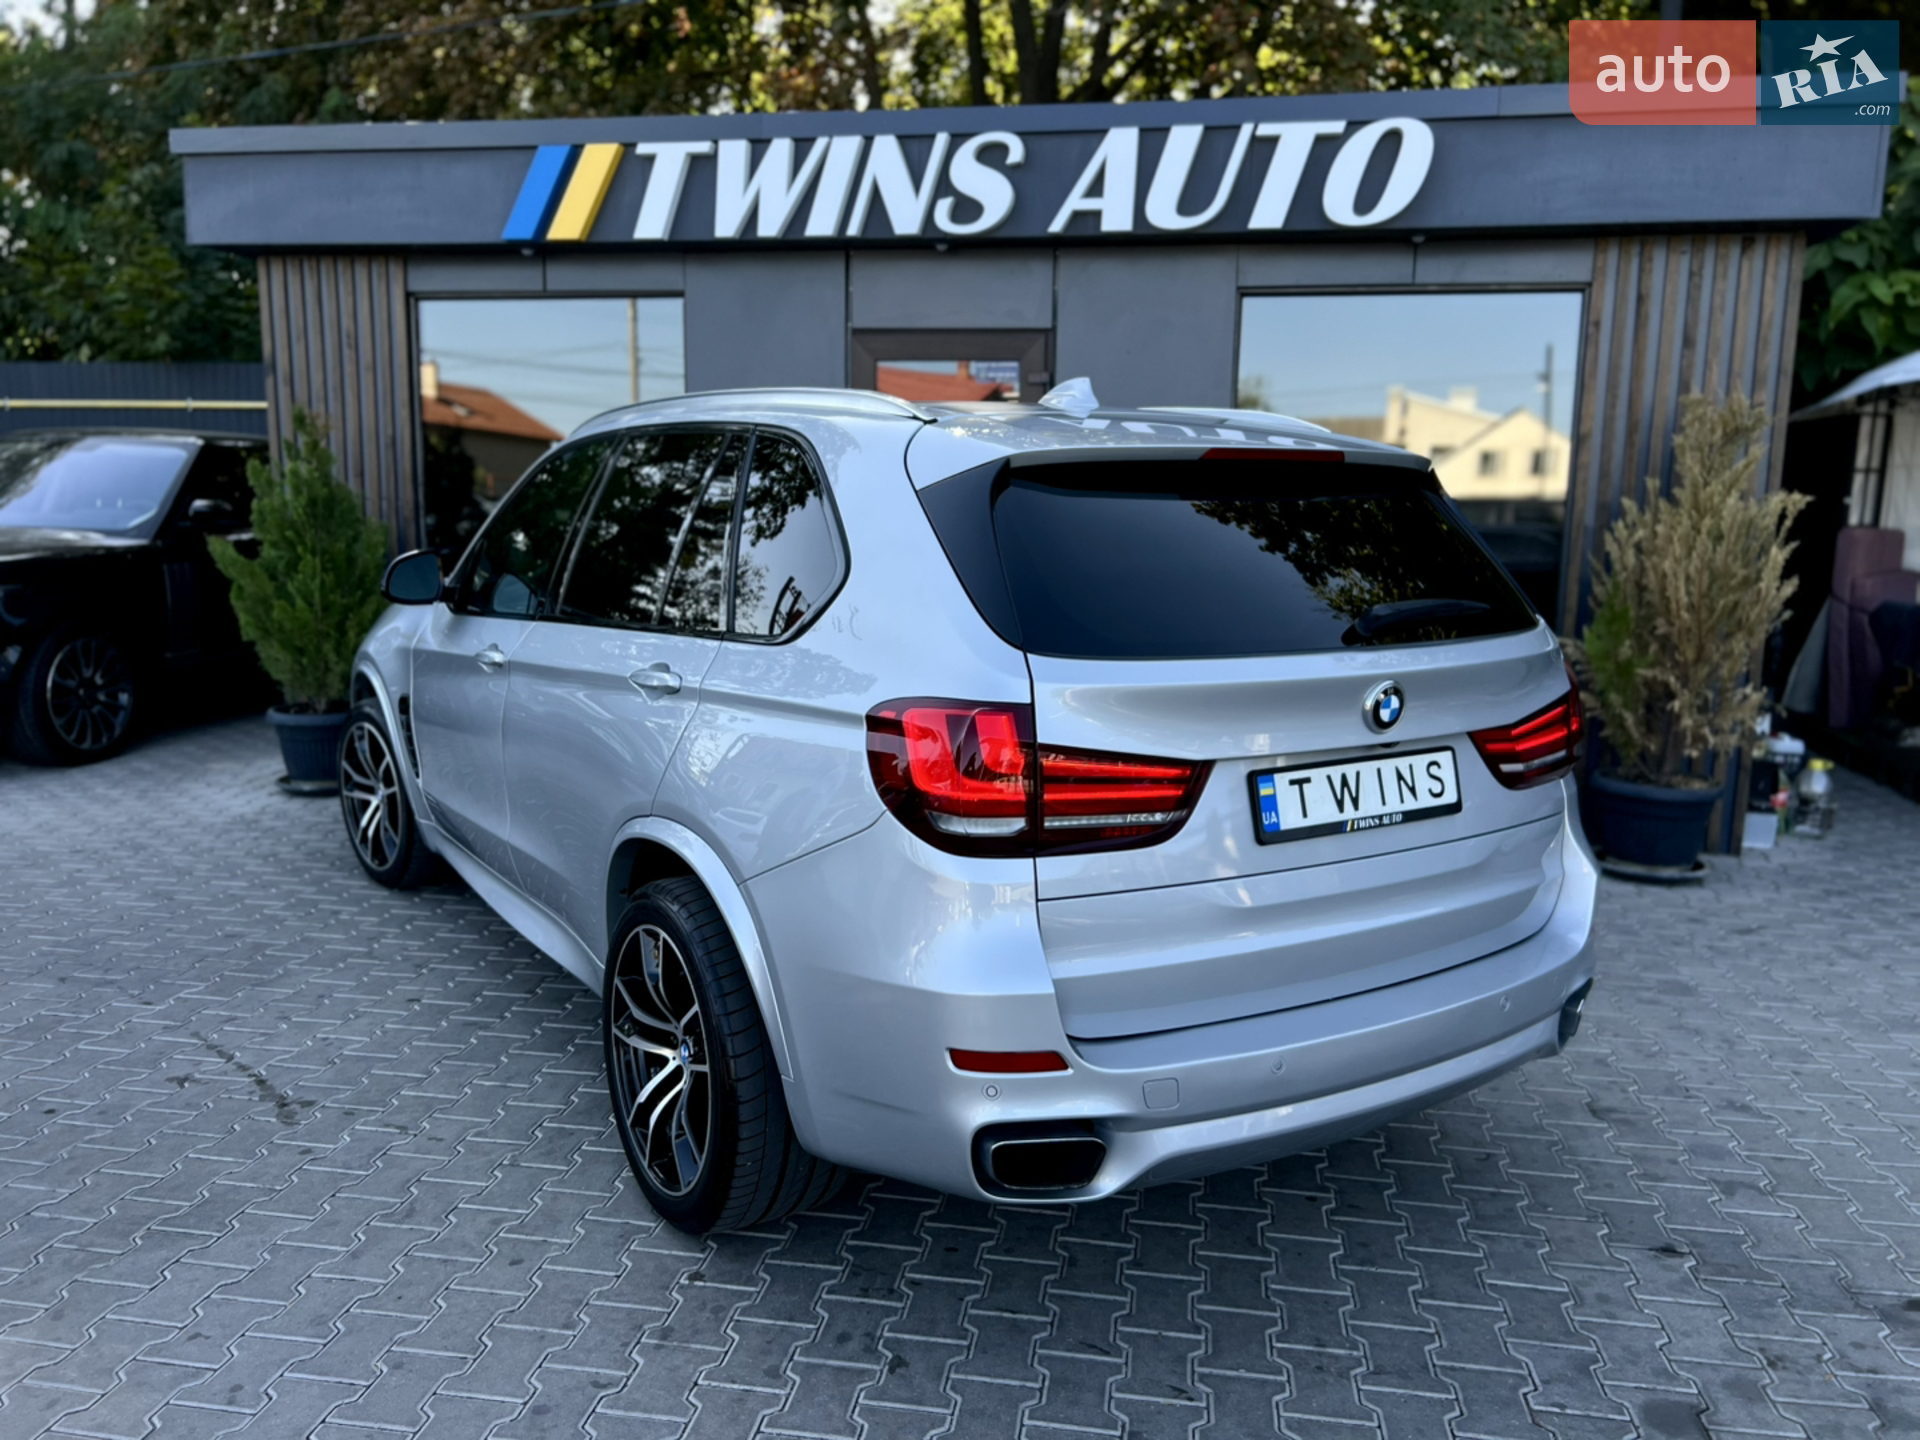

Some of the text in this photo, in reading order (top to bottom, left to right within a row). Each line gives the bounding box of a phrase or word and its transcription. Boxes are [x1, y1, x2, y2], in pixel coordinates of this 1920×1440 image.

[633, 117, 1435, 239] TWINS AUTO
[1262, 811, 1278, 825] UA
[1353, 812, 1403, 830] TWINS AUTO
